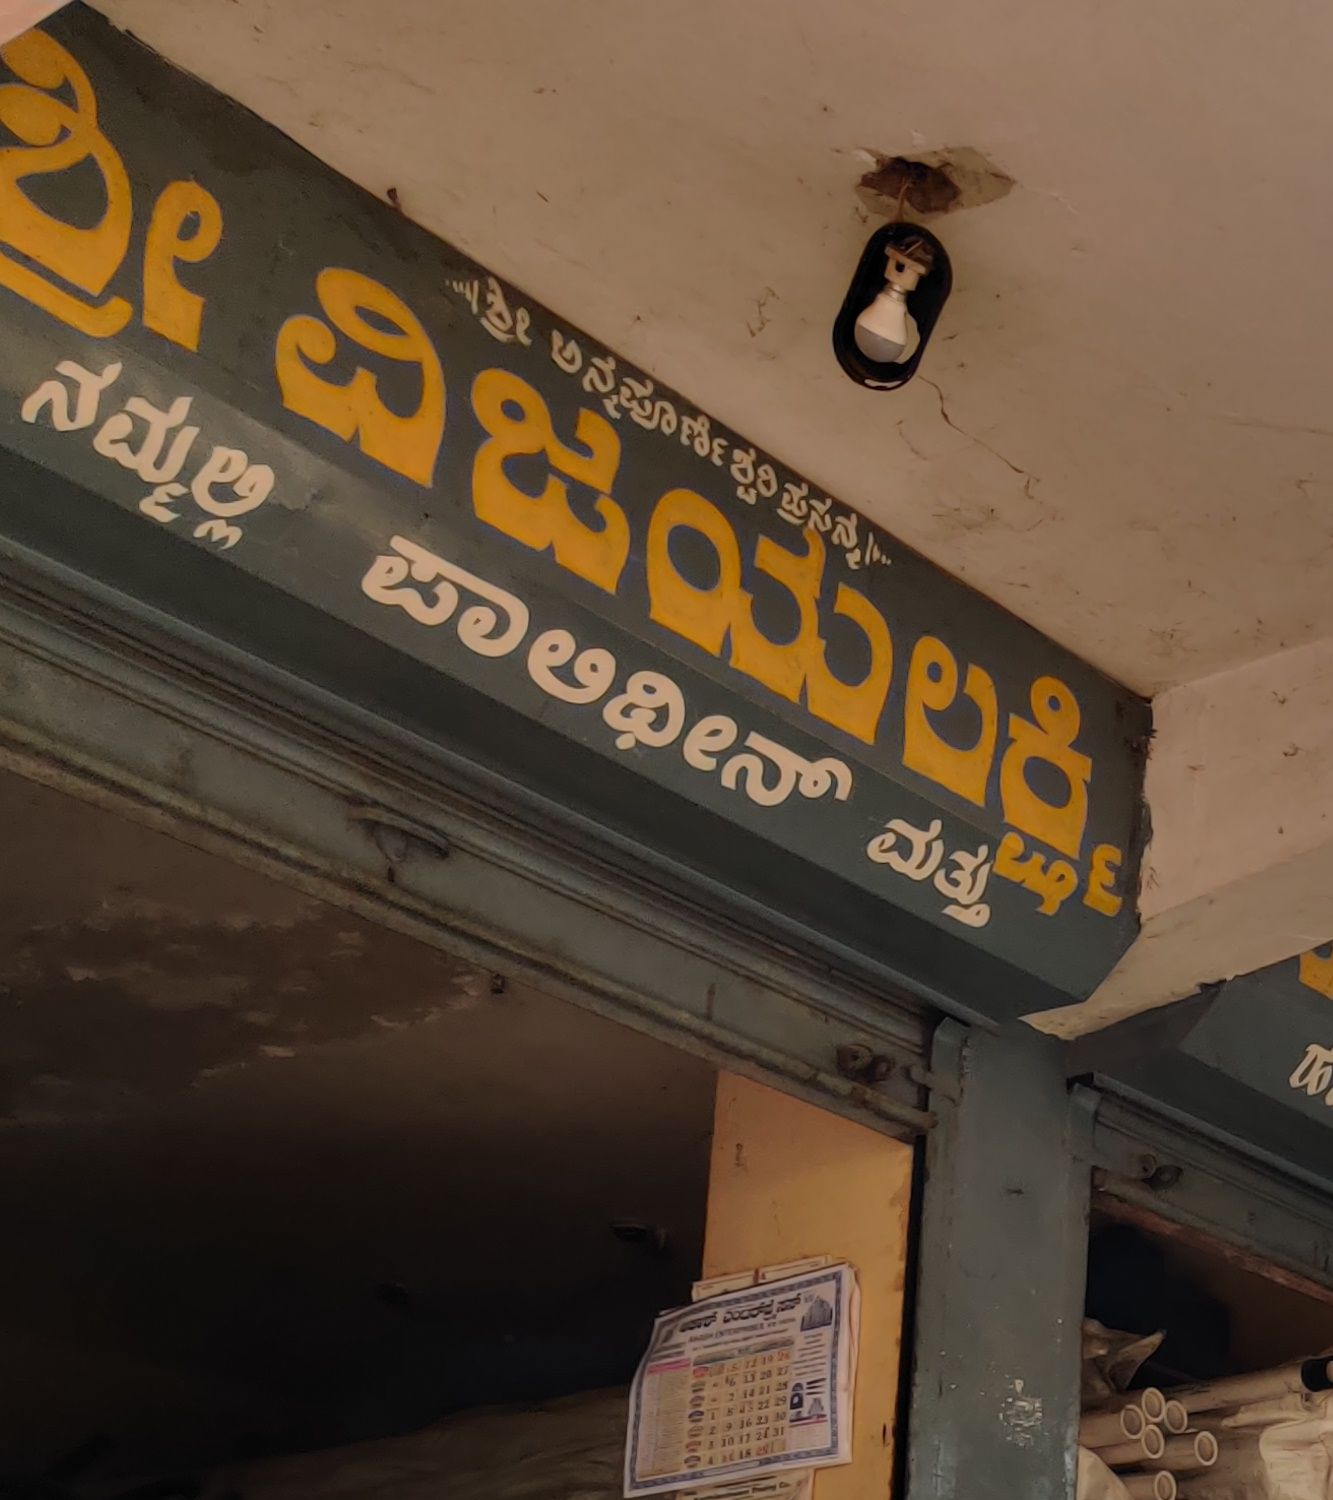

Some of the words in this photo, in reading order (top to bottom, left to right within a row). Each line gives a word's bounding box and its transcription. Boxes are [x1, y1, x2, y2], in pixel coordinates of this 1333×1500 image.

[0, 27, 222, 352] ಶ್ರೀ
[21, 359, 275, 550] ನಮ್ಮಲ್ಲಿ
[867, 818, 992, 929] ಮತ್ತು
